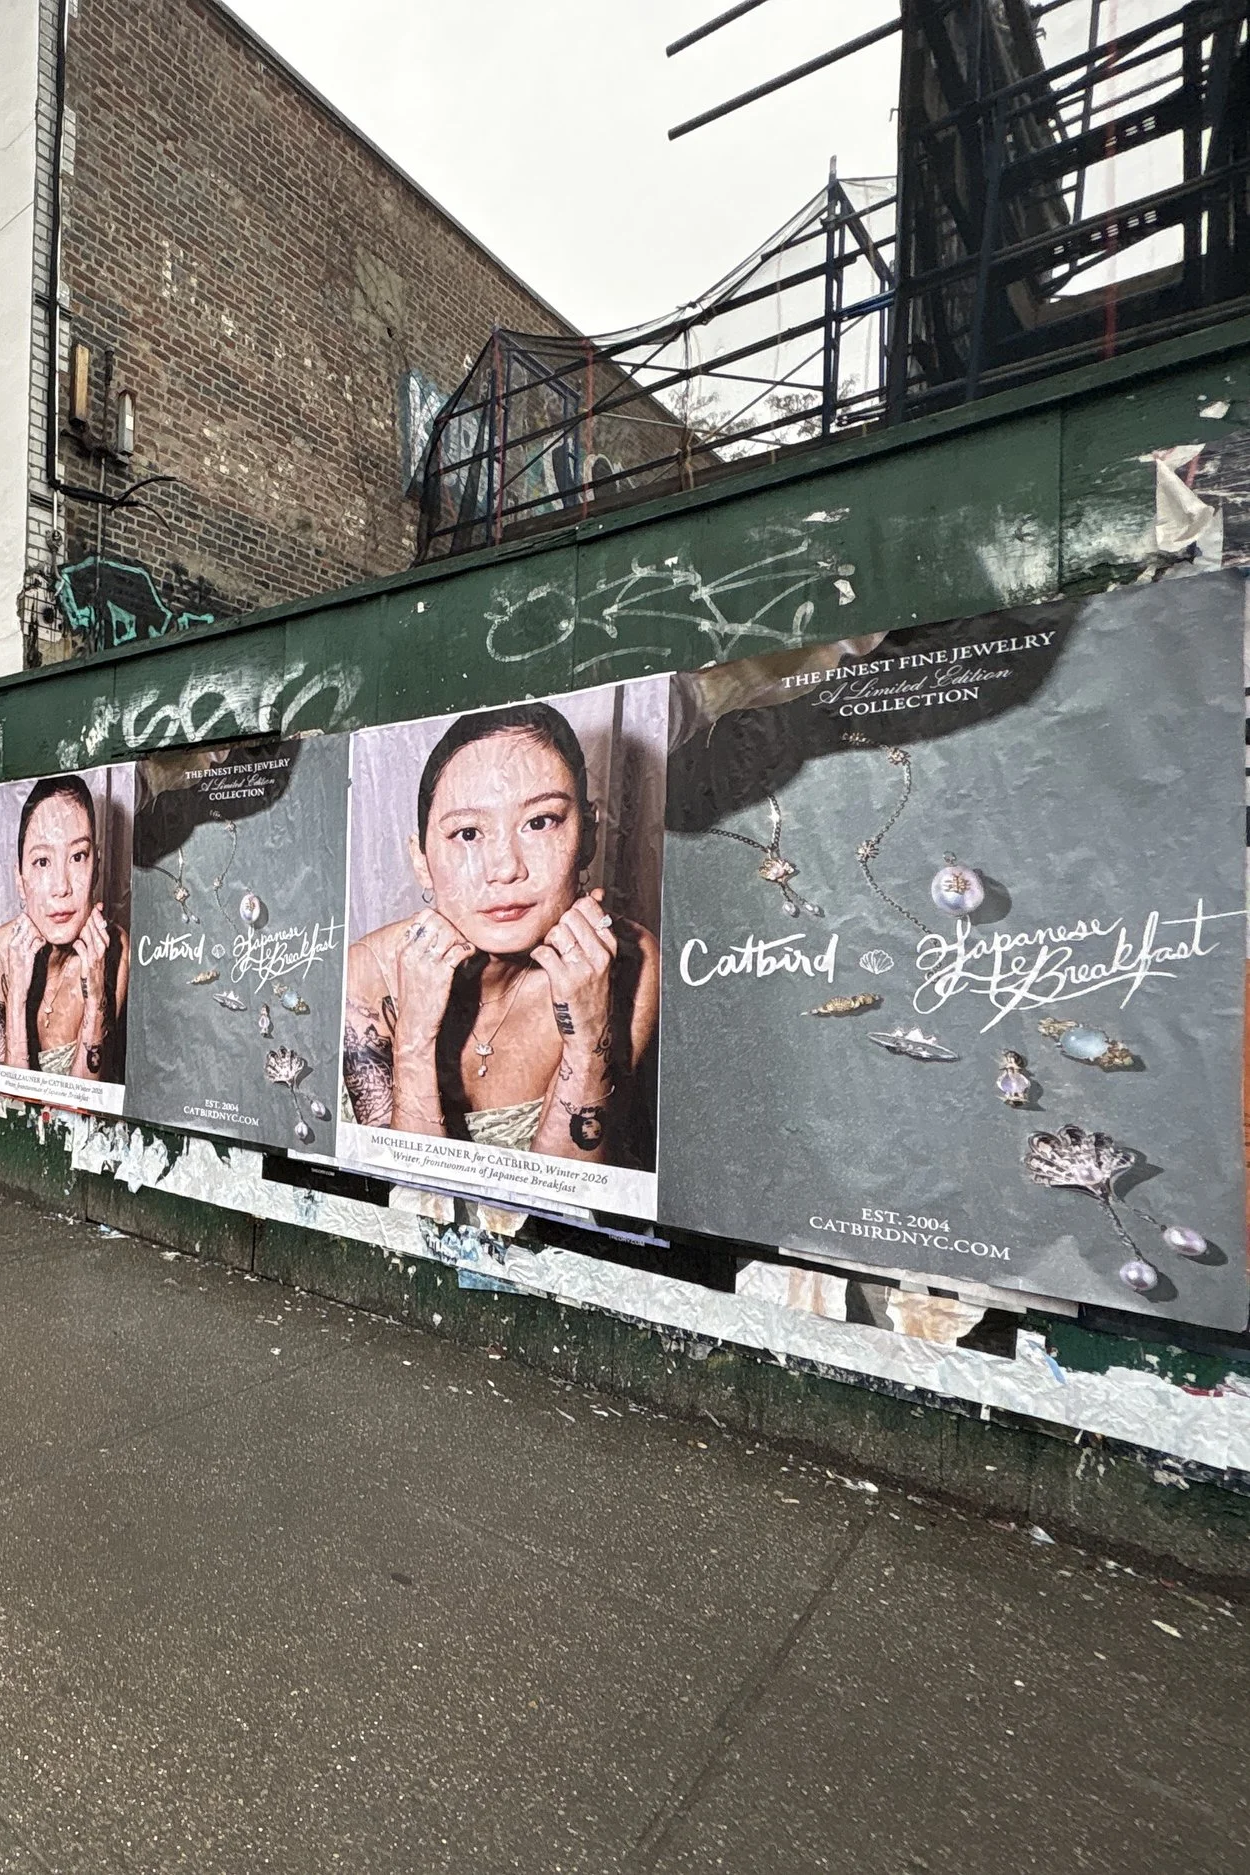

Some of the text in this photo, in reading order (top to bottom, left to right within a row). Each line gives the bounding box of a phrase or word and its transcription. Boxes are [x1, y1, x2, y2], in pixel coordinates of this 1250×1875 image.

[782, 630, 1057, 688] THE FINEST FINE JEWELRY
[811, 664, 1014, 706] A Limited Edition
[839, 686, 980, 717] COLLECTION
[185, 758, 290, 780] THE FINEST FINE JEWELRY
[211, 778, 245, 791] Limited
[209, 787, 265, 801] COLLECTION
[137, 932, 206, 967] Catbird
[231, 925, 307, 984] Japanese
[252, 916, 345, 995] Breakfast
[679, 933, 840, 986] Catbird
[913, 915, 1124, 1014] Japanese
[971, 898, 1248, 1034] Breakfast
[183, 1105, 259, 1126] CATBIRDNYC.COM
[205, 1099, 239, 1112] EST. 2004
[371, 1135, 609, 1186] MICHELLE ZAUNER for CATBIRD, Winter 2026
[392, 1151, 577, 1193] Writer, frontwoman of Japanese Breakfast
[809, 1215, 1011, 1261] CATBIRDNYC.COM
[861, 1207, 951, 1233] EST. 2004
